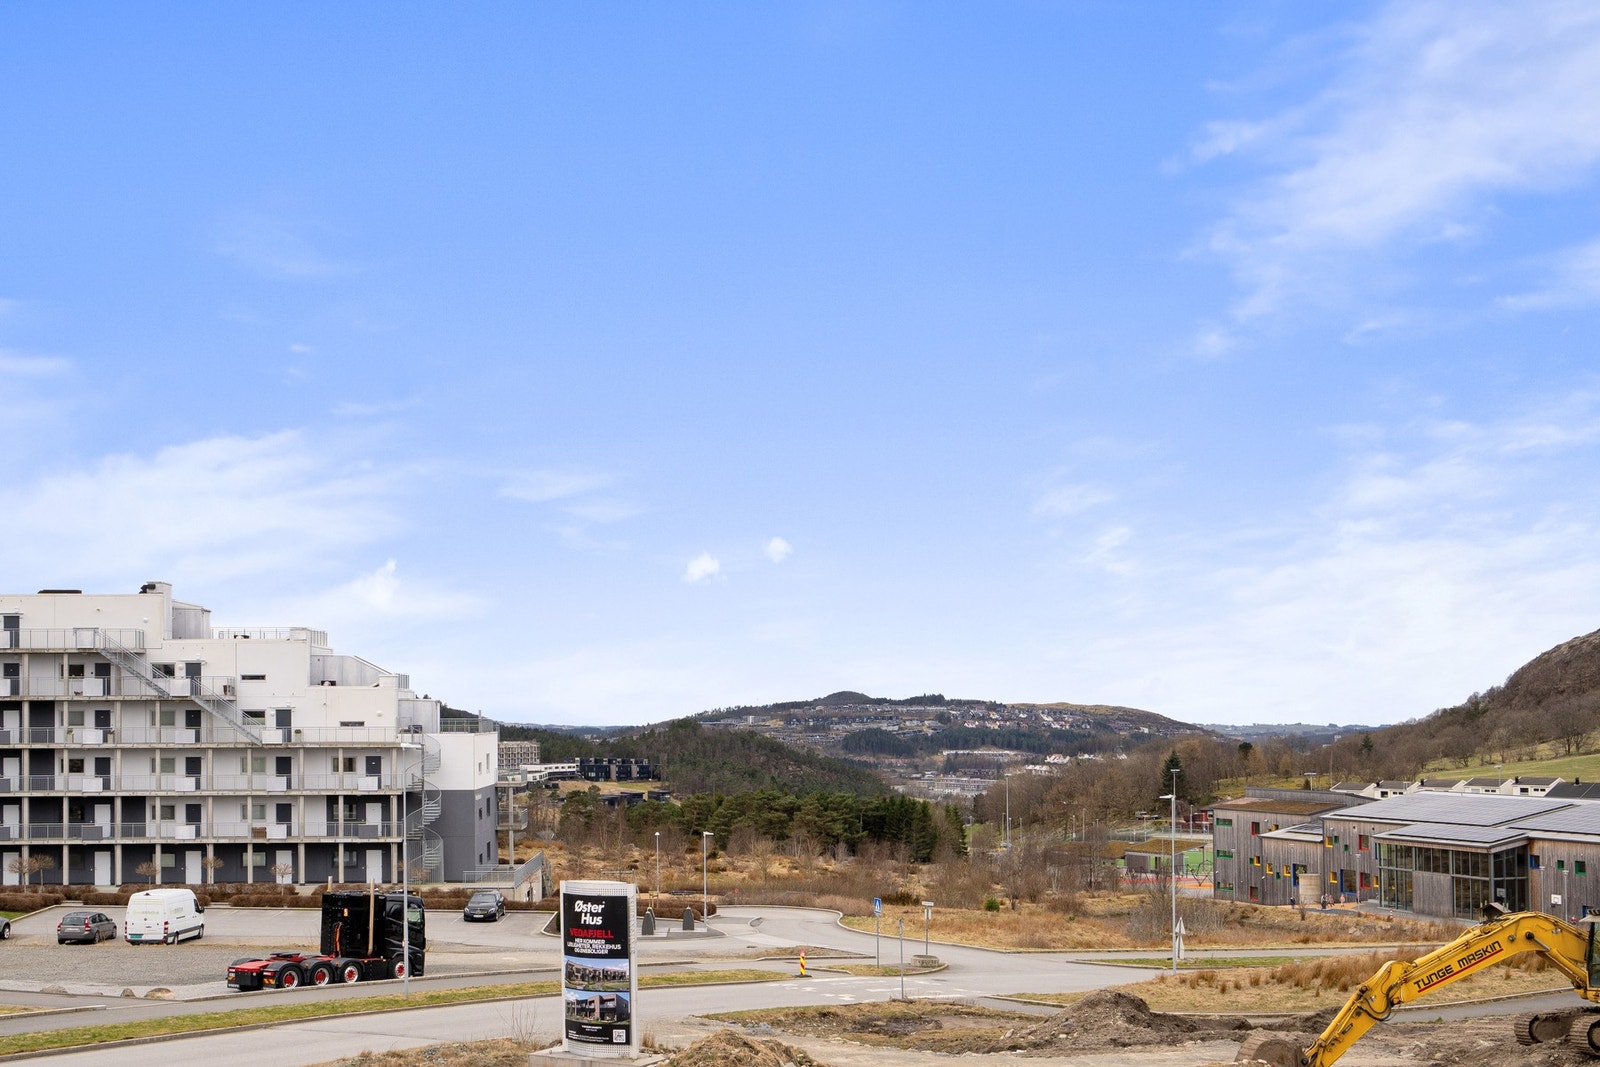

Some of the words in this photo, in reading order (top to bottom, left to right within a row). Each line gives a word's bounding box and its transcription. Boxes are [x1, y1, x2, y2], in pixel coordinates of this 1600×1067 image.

[574, 900, 605, 913] Øster
[581, 912, 603, 925] Hus
[569, 927, 614, 938] VEDAFJELL
[1413, 964, 1454, 989] TUNGE
[1457, 940, 1502, 968] MASKIN
